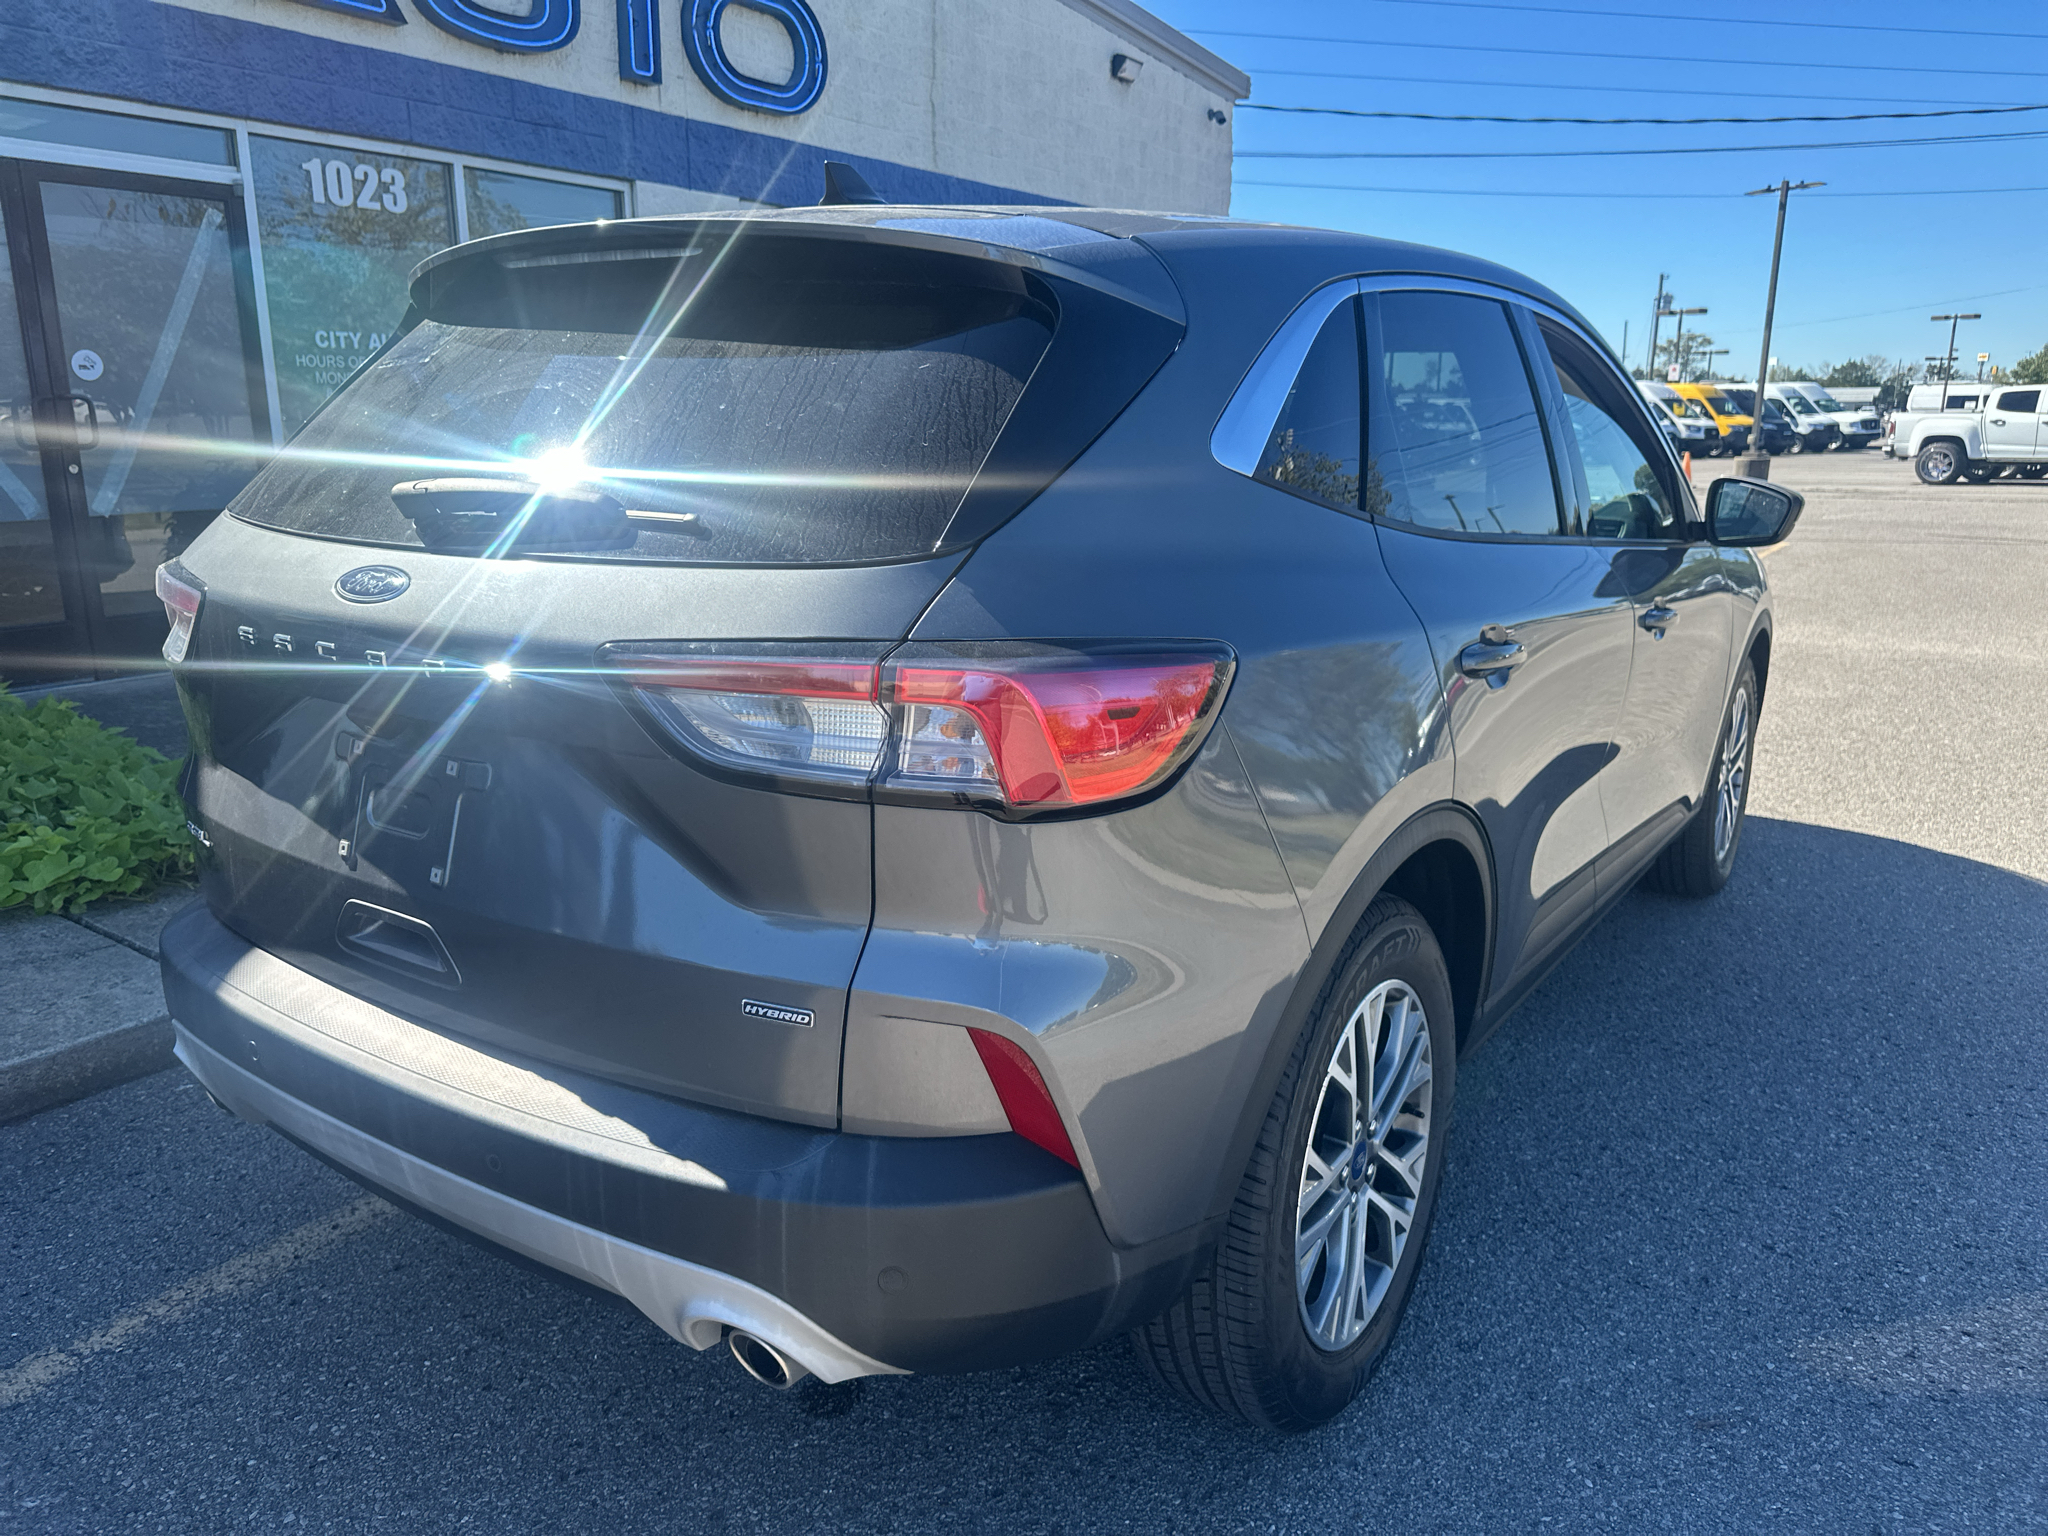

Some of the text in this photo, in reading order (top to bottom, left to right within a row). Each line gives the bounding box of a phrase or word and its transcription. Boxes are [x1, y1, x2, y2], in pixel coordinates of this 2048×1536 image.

[301, 158, 408, 214] 1023
[314, 330, 362, 350] CITY
[295, 353, 346, 369] HOURS
[315, 370, 351, 385] MON
[744, 1004, 810, 1025] HYBRID
